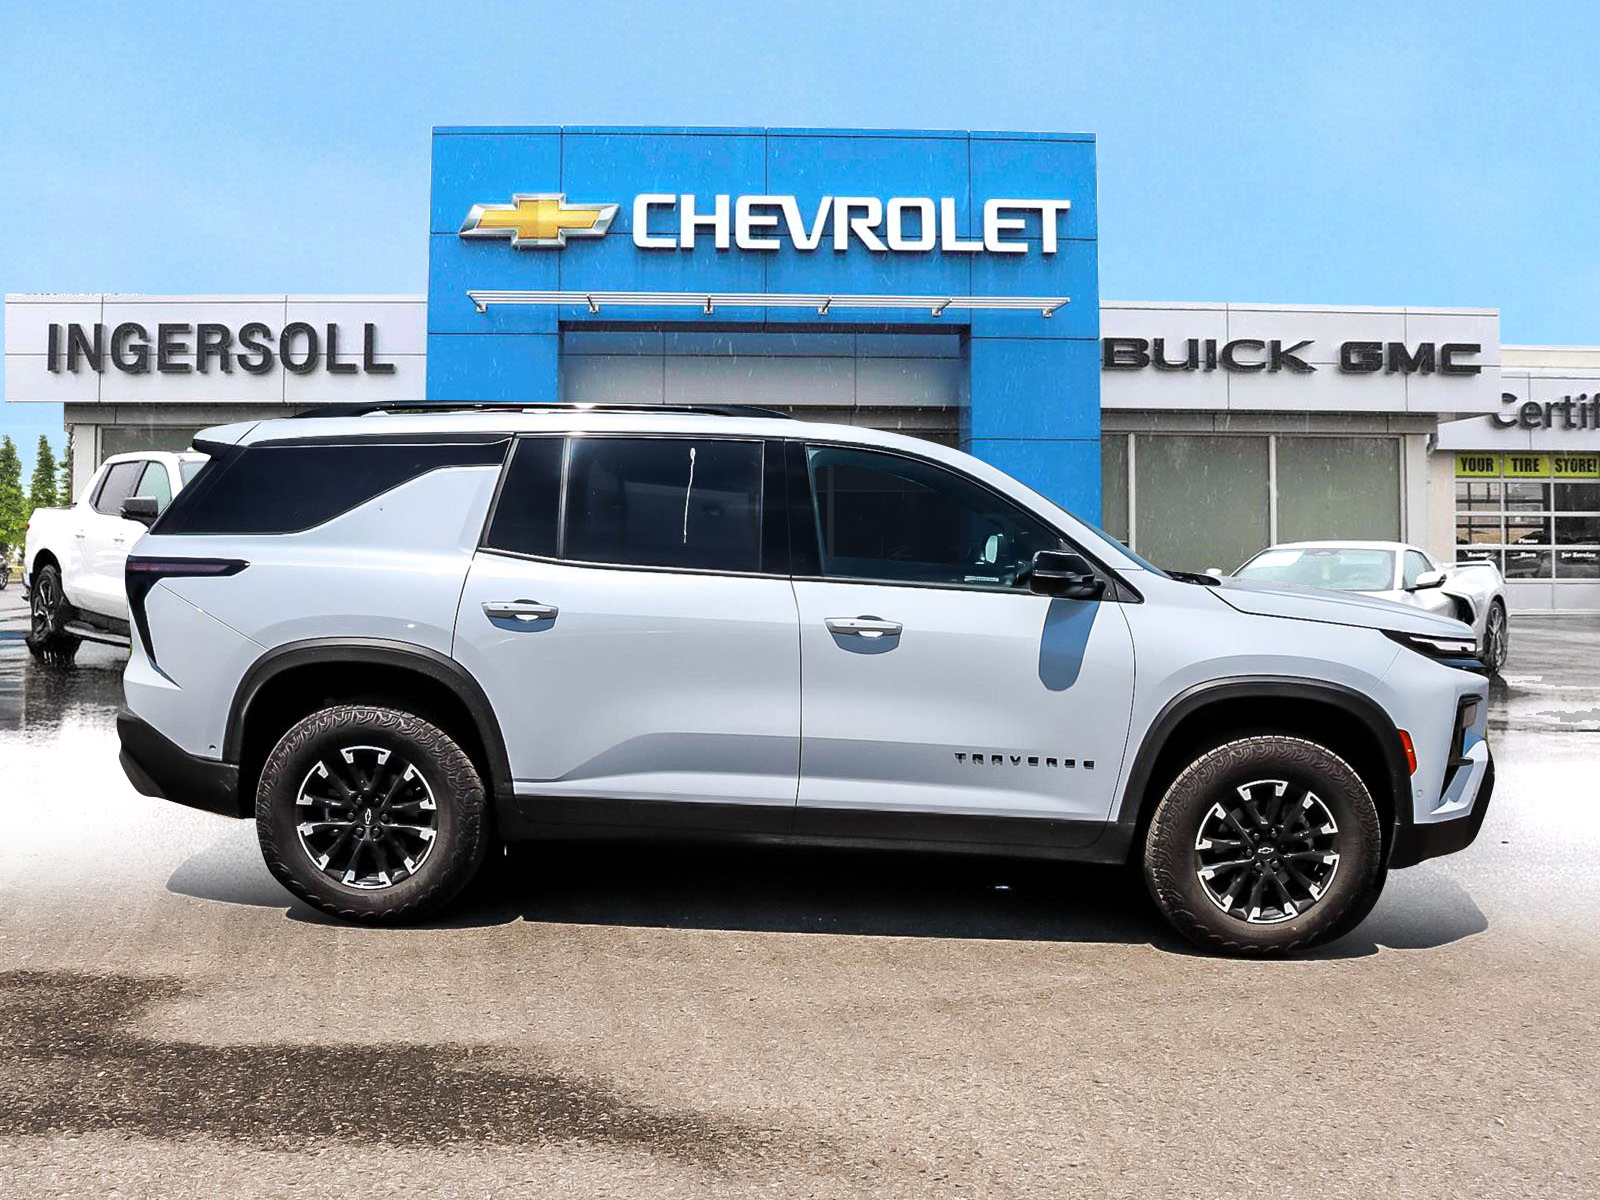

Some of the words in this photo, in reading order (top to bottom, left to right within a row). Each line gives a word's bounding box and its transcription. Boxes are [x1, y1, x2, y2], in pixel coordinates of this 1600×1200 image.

[632, 194, 1071, 255] CHEVROLET
[47, 322, 395, 375] INGERSOLL
[1102, 337, 1318, 373] BUICK
[1340, 341, 1482, 375] GMC
[1460, 457, 1494, 473] YOUR
[1511, 458, 1540, 473] TIRE
[1555, 458, 1598, 474] STORE!
[954, 752, 1095, 770] TRAVERSE
